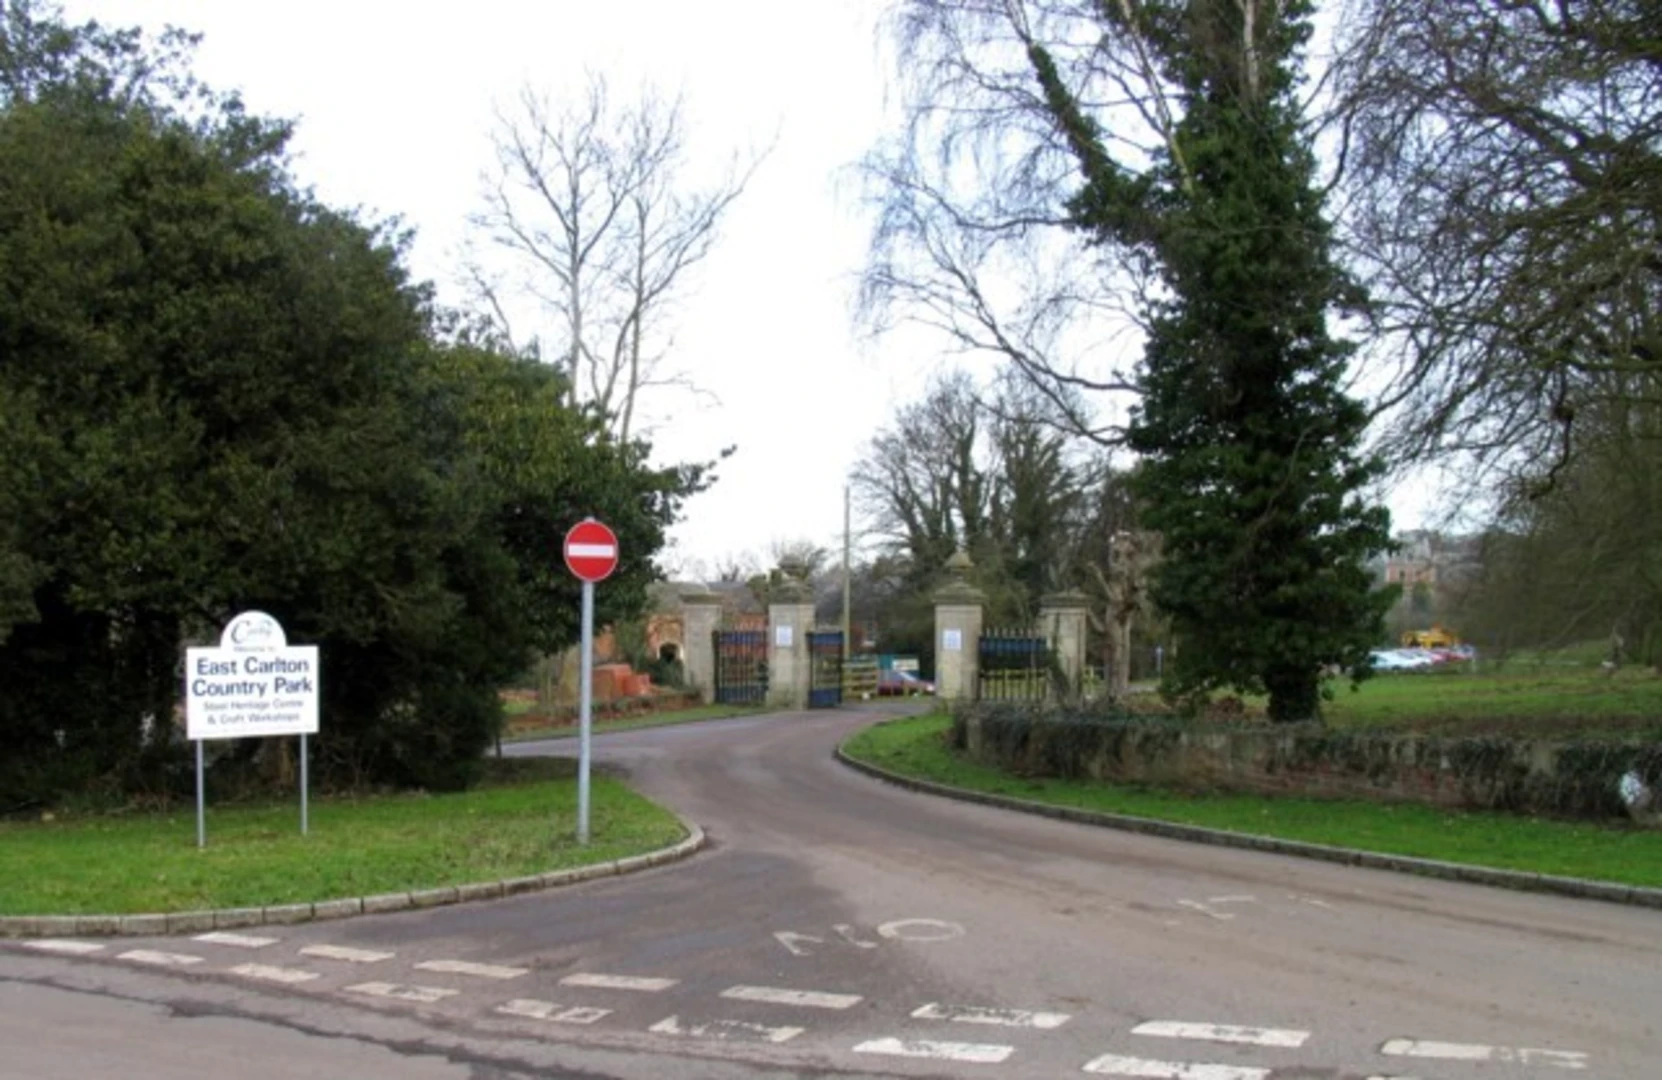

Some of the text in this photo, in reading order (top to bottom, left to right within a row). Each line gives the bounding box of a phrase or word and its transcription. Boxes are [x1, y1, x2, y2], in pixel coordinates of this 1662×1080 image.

[196, 656, 310, 675] East Carlton
[191, 676, 313, 698] Country Park
